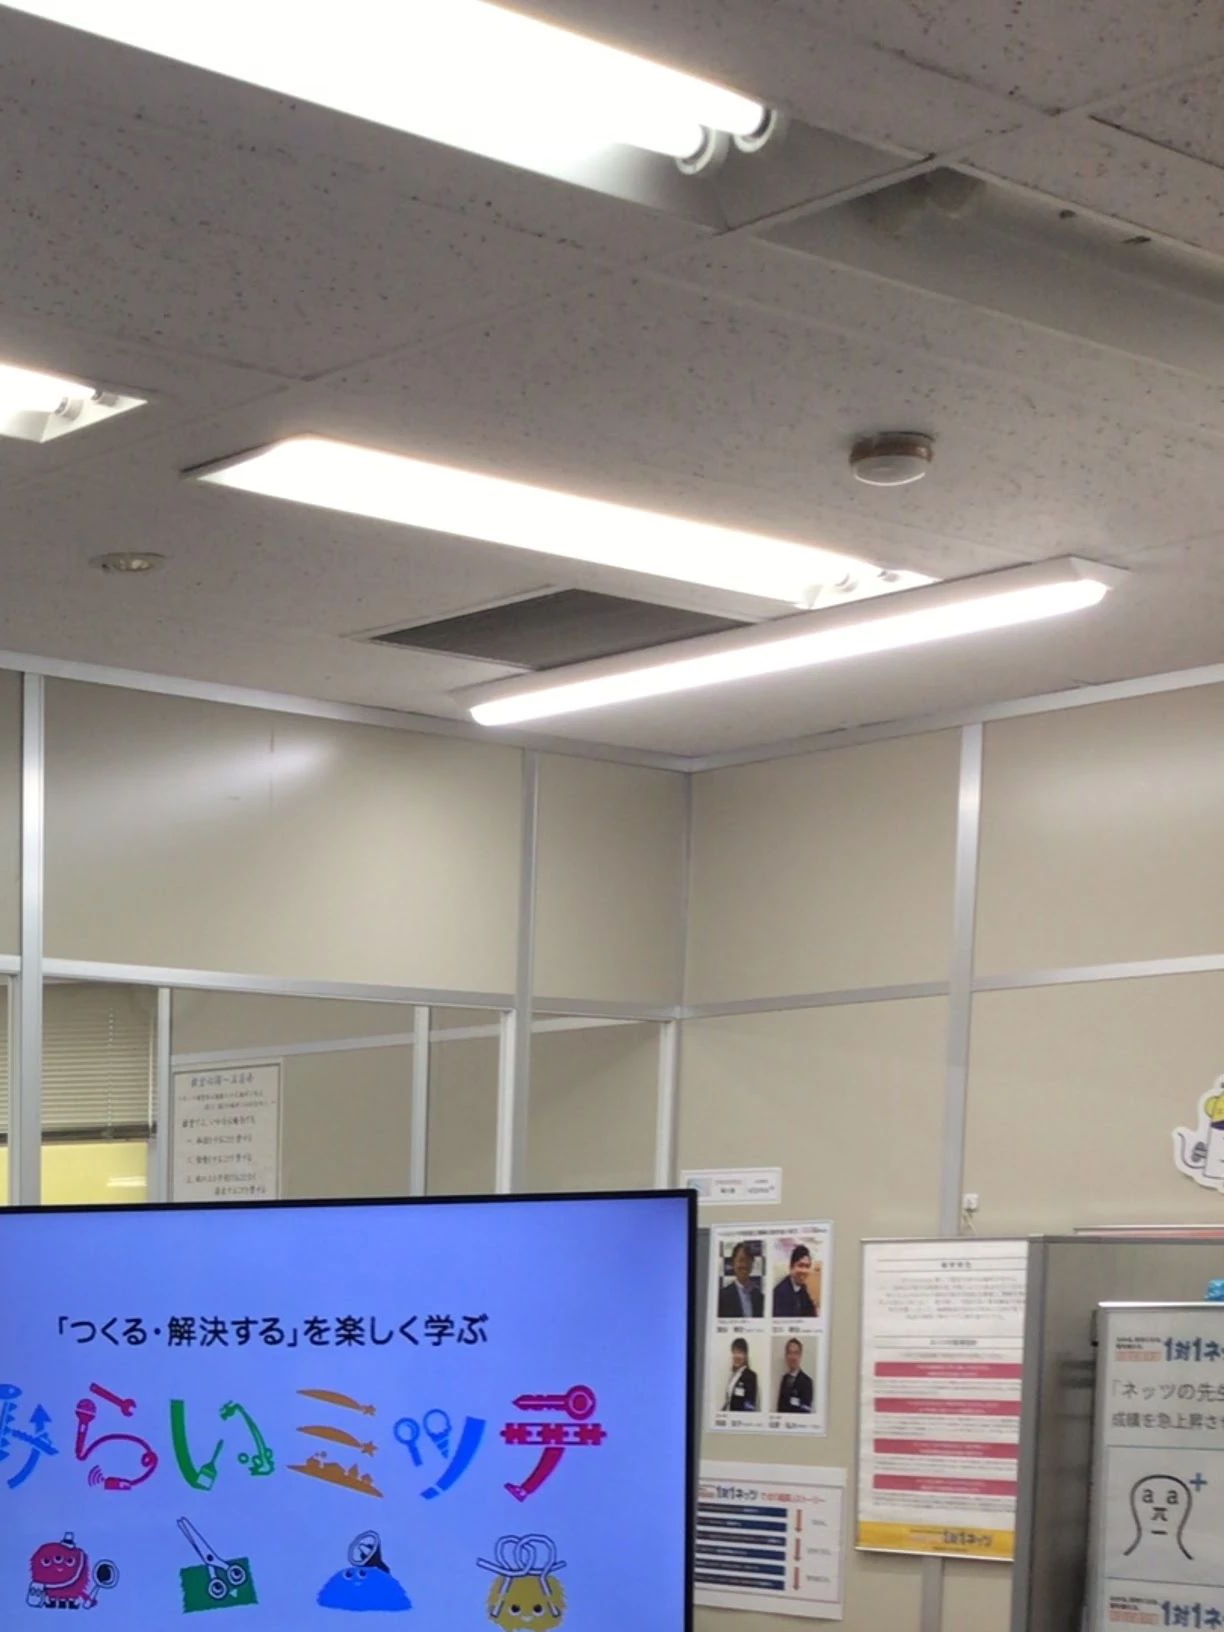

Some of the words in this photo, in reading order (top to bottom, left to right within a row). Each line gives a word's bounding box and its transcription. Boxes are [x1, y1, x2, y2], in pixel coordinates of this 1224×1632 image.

[57, 1312, 490, 1348] 「つくる・解決する」を楽しく学ぶ
[1164, 1336, 1224, 1362] 1対1ネ
[1161, 1600, 1224, 1630] 1対1ネ
